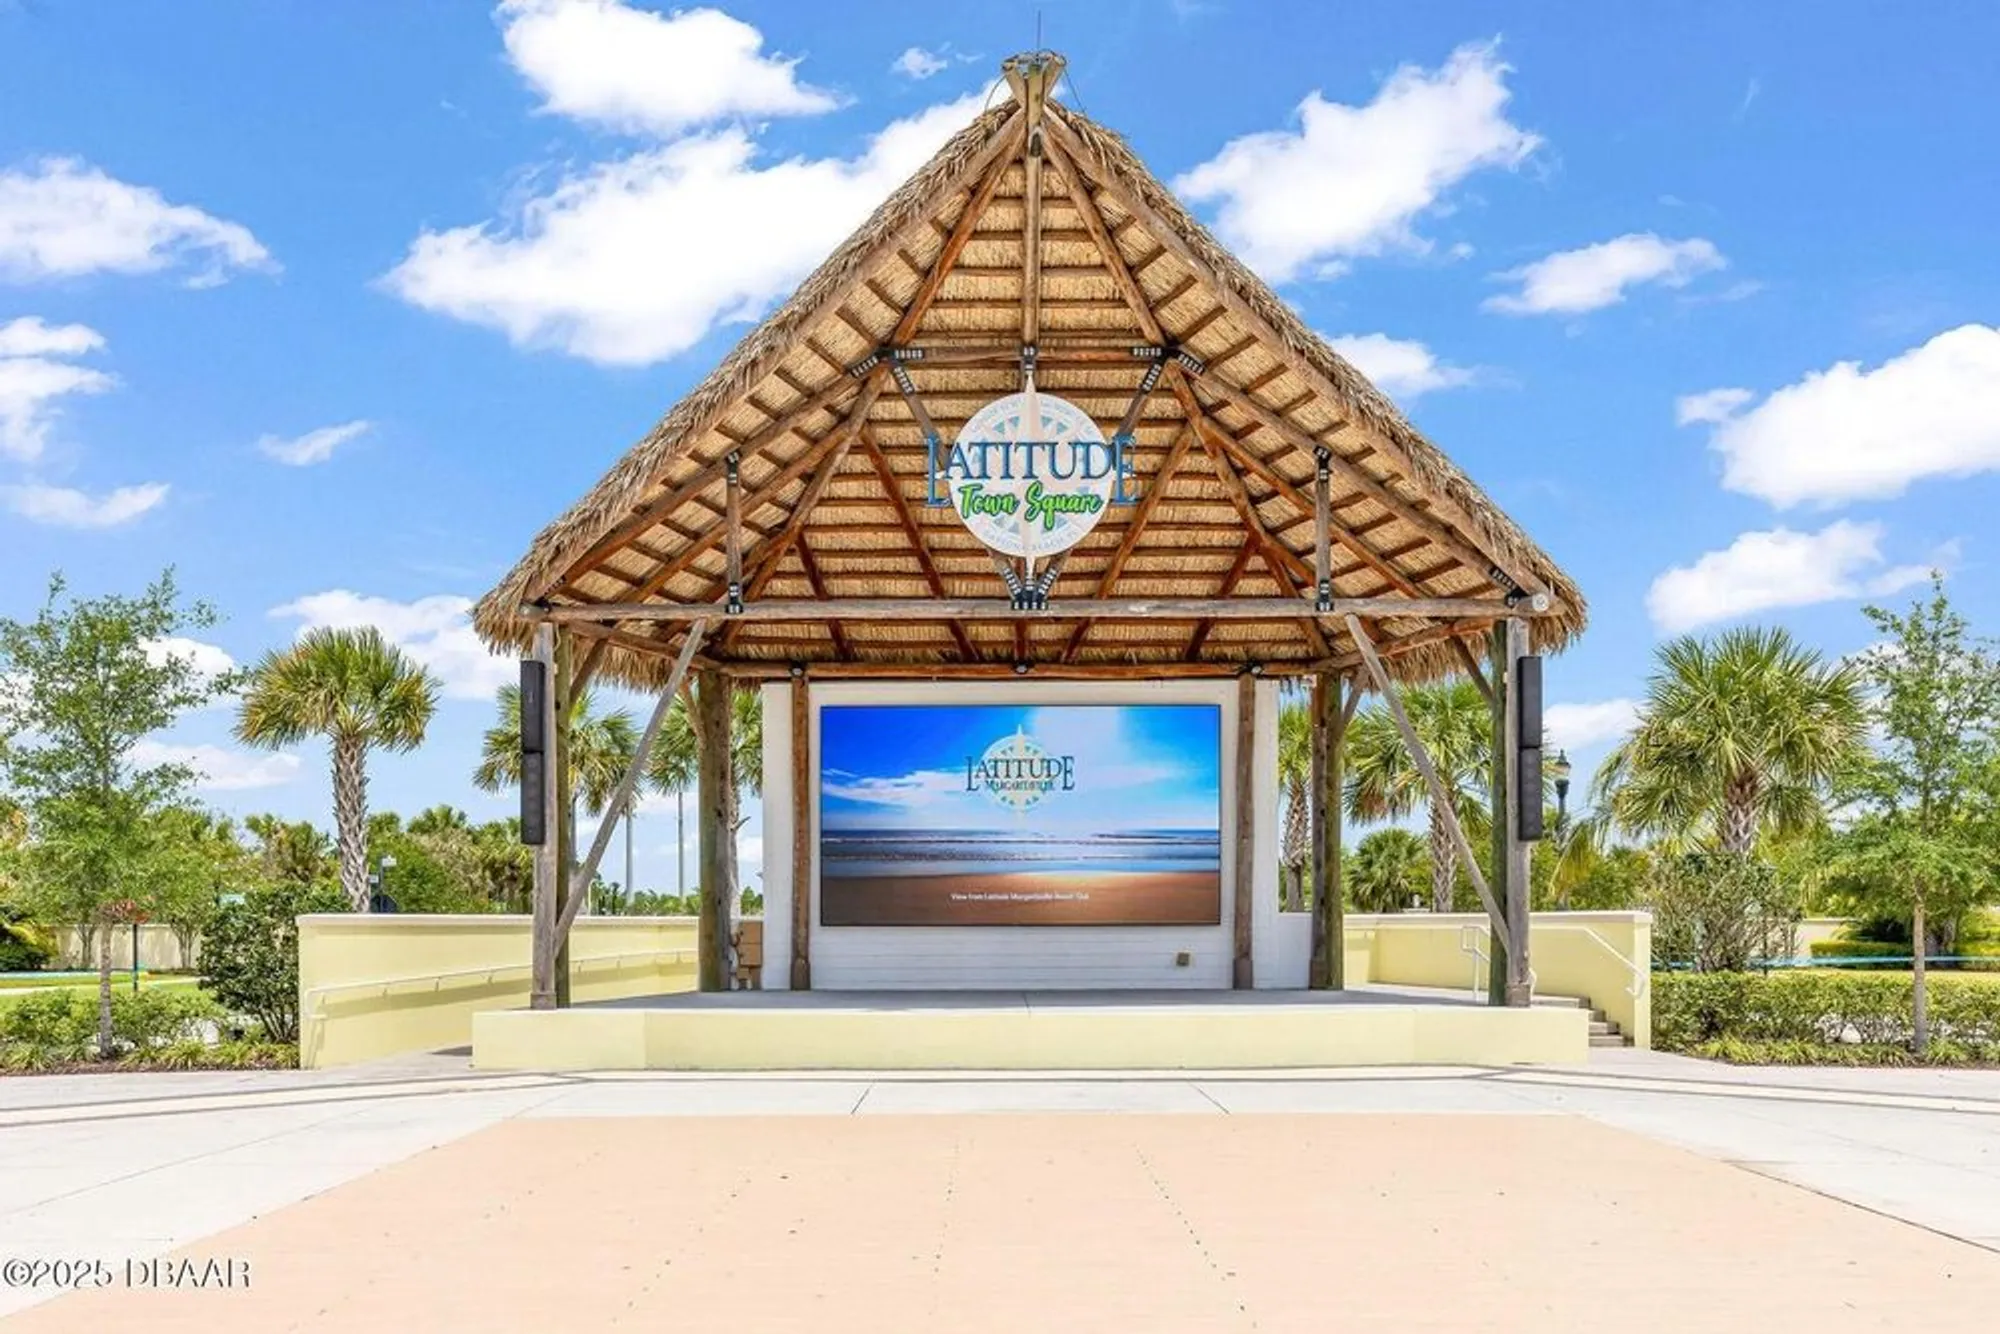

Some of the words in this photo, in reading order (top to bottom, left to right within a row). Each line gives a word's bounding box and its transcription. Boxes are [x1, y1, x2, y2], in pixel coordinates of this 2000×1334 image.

[925, 432, 1137, 507] LATITUDE
[958, 482, 1019, 519] Town
[1024, 480, 1104, 531] Square
[965, 755, 1076, 792] LATITUDE
